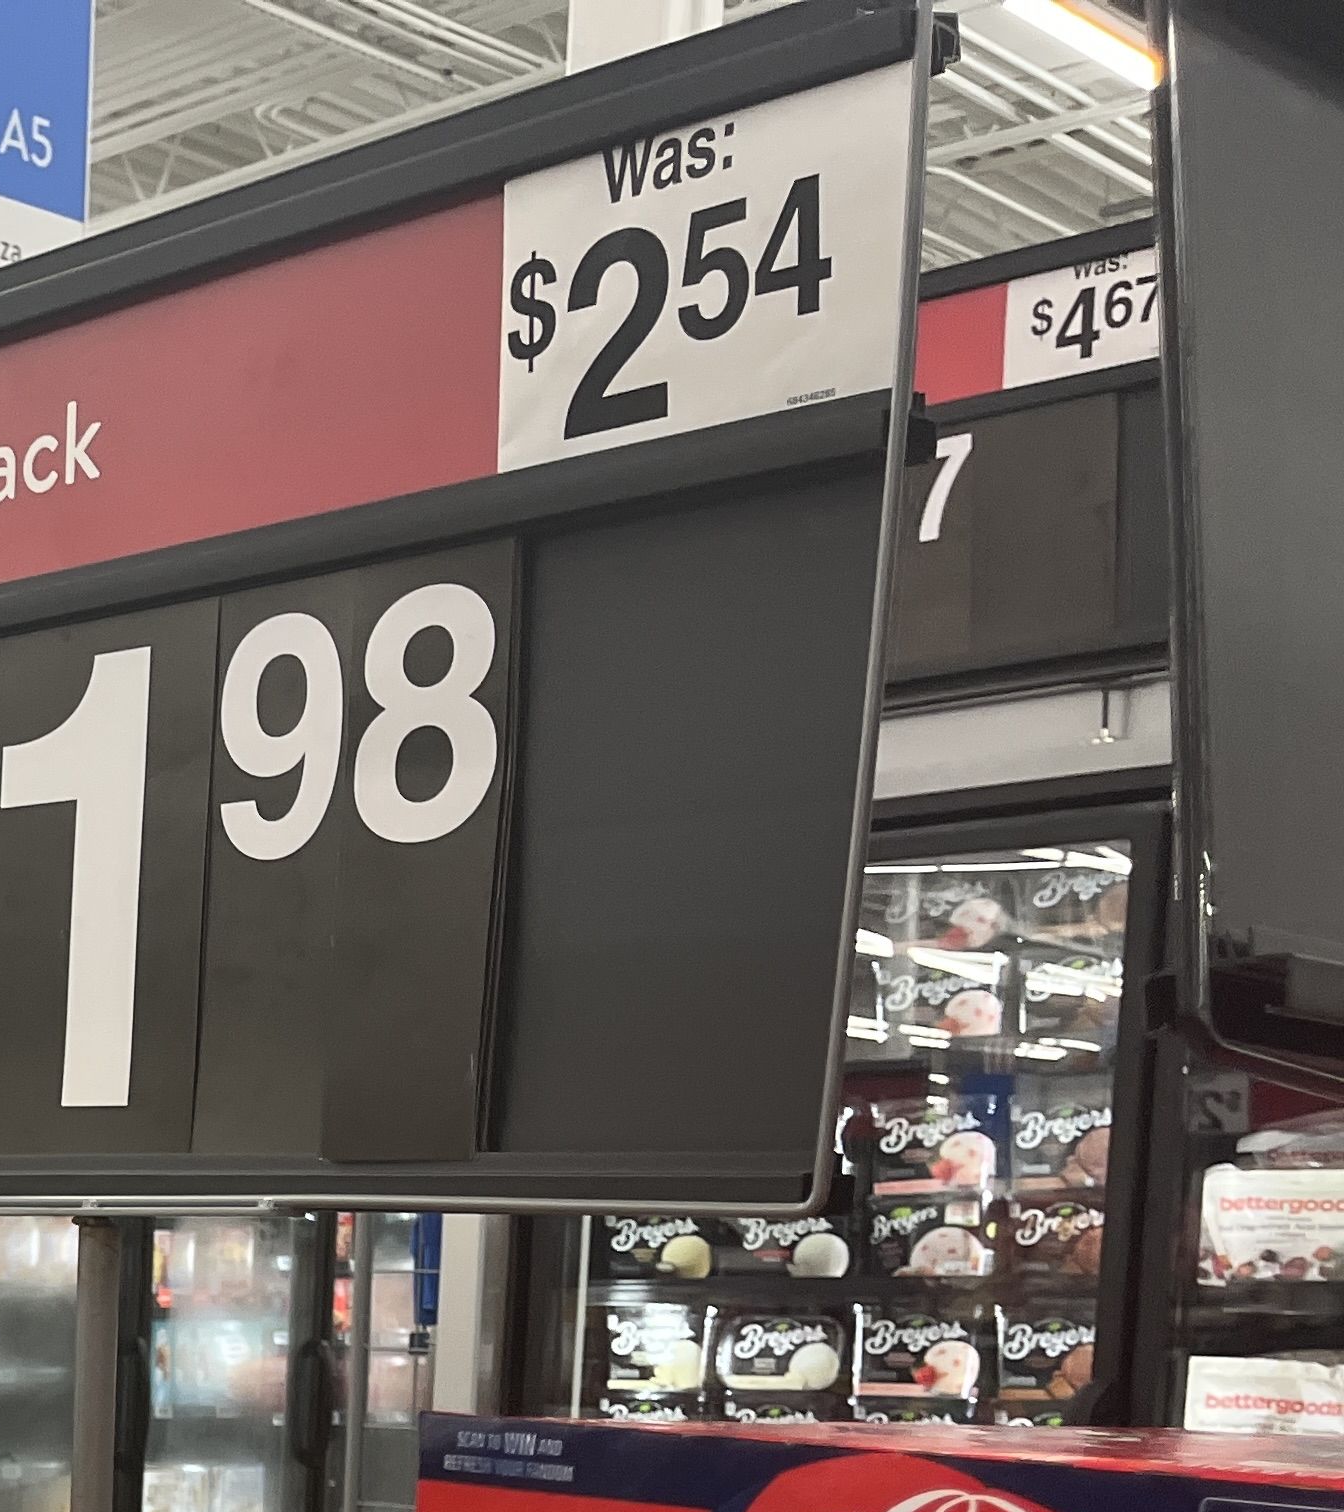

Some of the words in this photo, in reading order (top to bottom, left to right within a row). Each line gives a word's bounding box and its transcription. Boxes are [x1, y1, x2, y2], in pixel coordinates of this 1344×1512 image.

[601, 120, 735, 204] Was:
[734, 1321, 829, 1359] Breyers
[864, 1318, 971, 1356] Breyers
